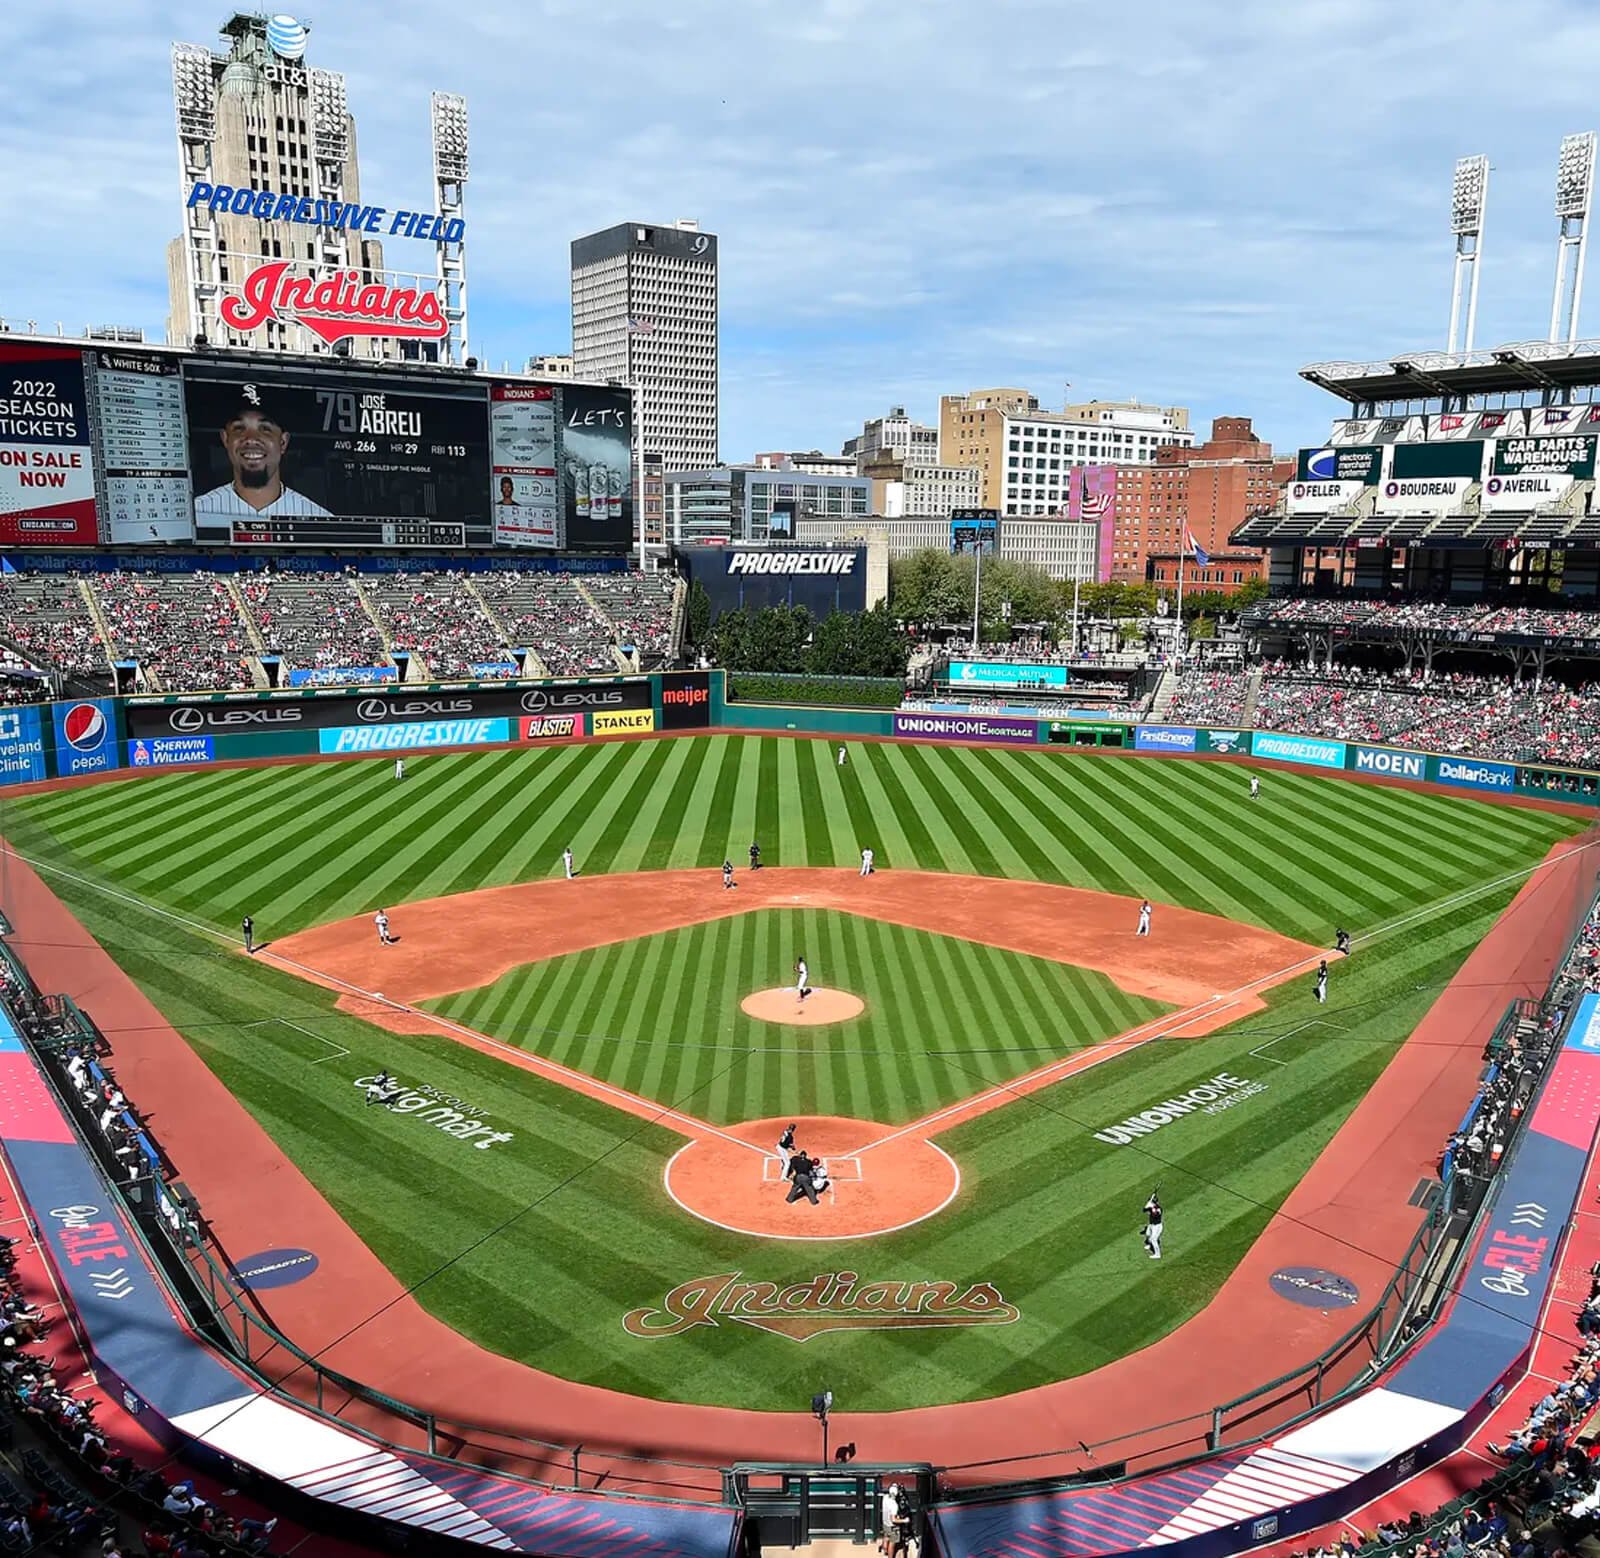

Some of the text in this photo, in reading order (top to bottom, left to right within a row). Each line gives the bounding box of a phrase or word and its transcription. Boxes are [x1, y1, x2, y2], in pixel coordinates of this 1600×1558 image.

[264, 62, 308, 87] at&
[187, 182, 466, 243] PROGRESSIVE FIELD
[690, 235, 709, 256] 9
[220, 261, 450, 344] Indians
[113, 358, 142, 370] WHITE
[144, 363, 161, 373] SOX
[12, 380, 56, 398] 2022
[503, 390, 535, 399] INDIANS
[0, 399, 74, 418] SEASON
[360, 391, 386, 410] JOSÉ
[316, 392, 357, 432] 79
[568, 408, 625, 427] LET'S
[0, 419, 77, 438] TICKETS
[360, 409, 421, 436] ABREU
[354, 441, 376, 452] .266
[390, 443, 404, 453] HR
[404, 443, 418, 454] 29
[431, 445, 446, 455] RBI
[447, 446, 466, 457] 113
[1508, 437, 1586, 452] CAR PARTS
[0, 451, 82, 468] ON SALE
[1503, 449, 1588, 464] WAREHOUSE
[19, 471, 66, 488] NOW
[1502, 479, 1552, 493] AVERILL
[1306, 484, 1341, 497] FELLER
[1399, 481, 1456, 497] BOUDREAU
[251, 533, 266, 541] CLE
[728, 553, 857, 574] PROGRESSIVE
[978, 669, 1054, 679] MEDICAL MUTUAL
[550, 692, 623, 706] LEXUS
[662, 686, 708, 706] meijer
[207, 708, 303, 725] LEXUS
[390, 700, 473, 716] LEXUS
[1037, 707, 1069, 718] MOEN
[1108, 710, 1141, 721] MOEN
[528, 717, 575, 737] BLASTER
[595, 714, 652, 730] STANLEY
[897, 717, 1033, 738] UNIONHOME MORTGAGE
[336, 719, 496, 751] PROGRESSIVE
[1140, 730, 1195, 747] FirstEnergy
[153, 740, 206, 752] SHERWIN
[1257, 738, 1338, 761] PROGRESSIVE
[72, 753, 107, 771] pepsi
[152, 750, 209, 763] WILLIAMS.
[1357, 750, 1421, 775] MOEN
[1439, 762, 1511, 787] DollarBank
[415, 1084, 490, 1118] DISCOUNT
[1092, 1072, 1250, 1145] UNIONHOME
[622, 1270, 1021, 1342] Indians
